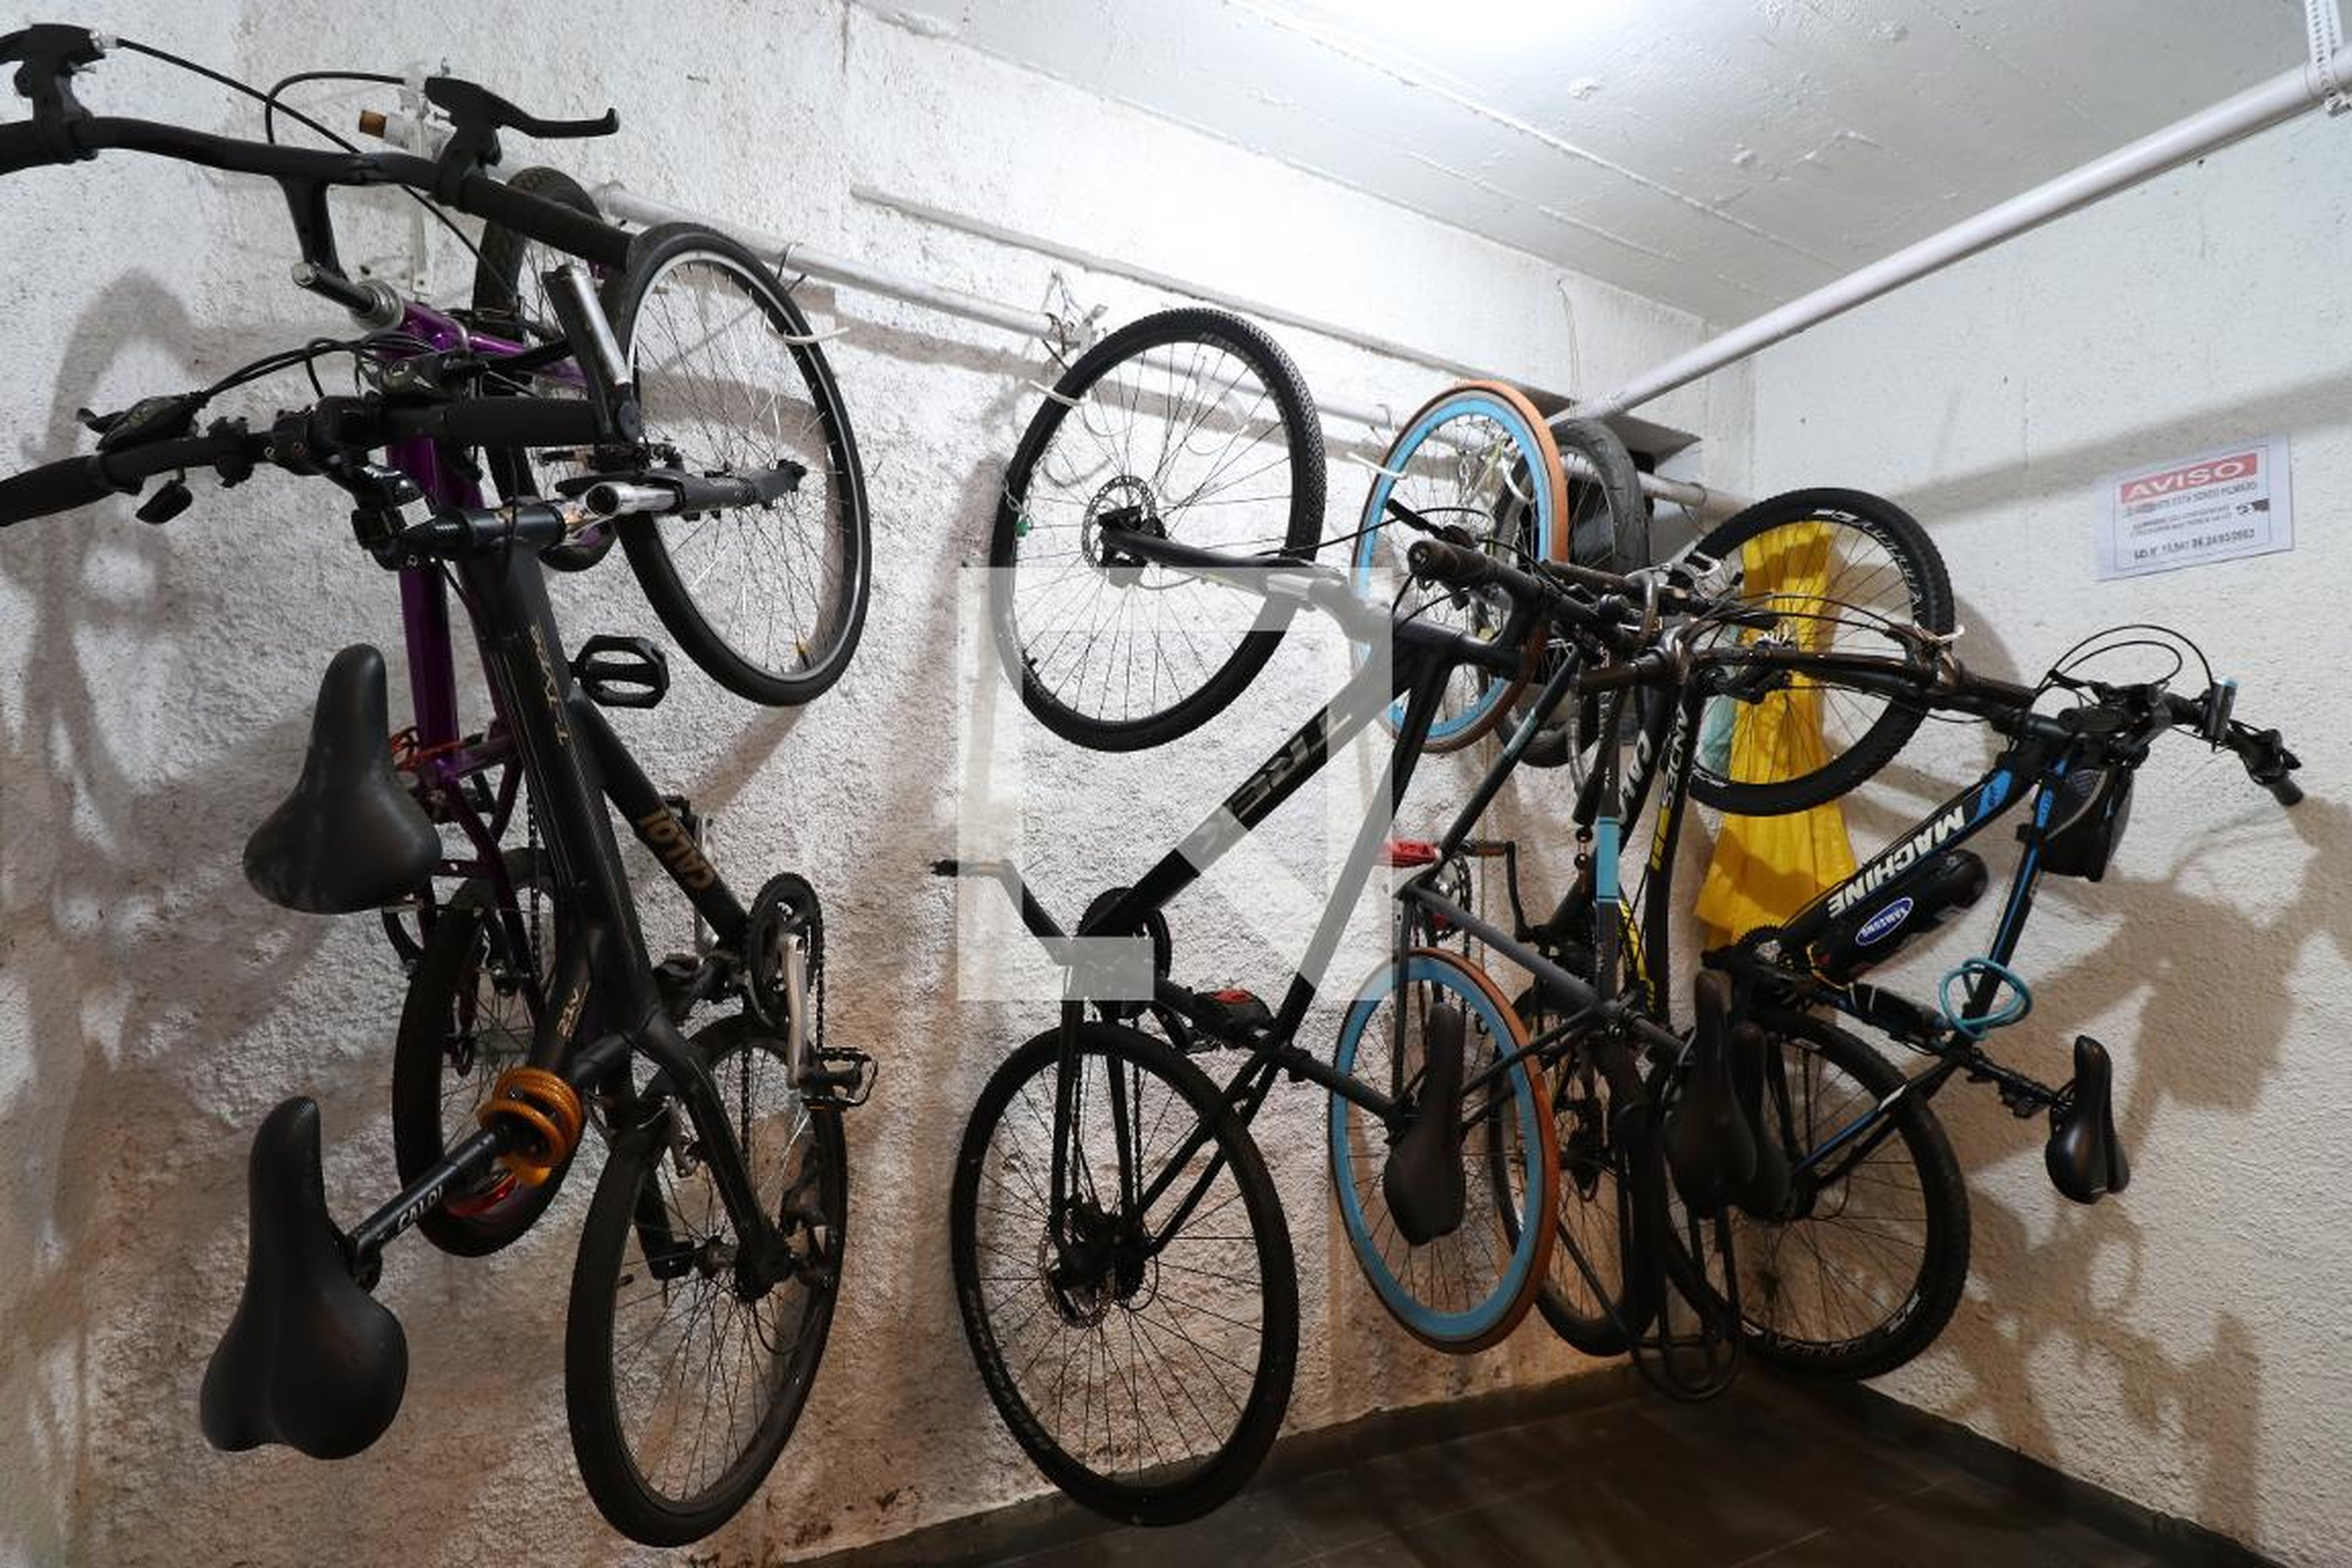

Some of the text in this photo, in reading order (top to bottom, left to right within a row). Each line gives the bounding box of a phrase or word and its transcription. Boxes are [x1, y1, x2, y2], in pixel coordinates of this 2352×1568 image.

[2128, 461, 2244, 498] AVISO
[638, 810, 714, 891] CALOI
[1828, 806, 1965, 918] MACHINE
[1861, 907, 1906, 937] SAMSUNG
[398, 1185, 443, 1231] CALOI
